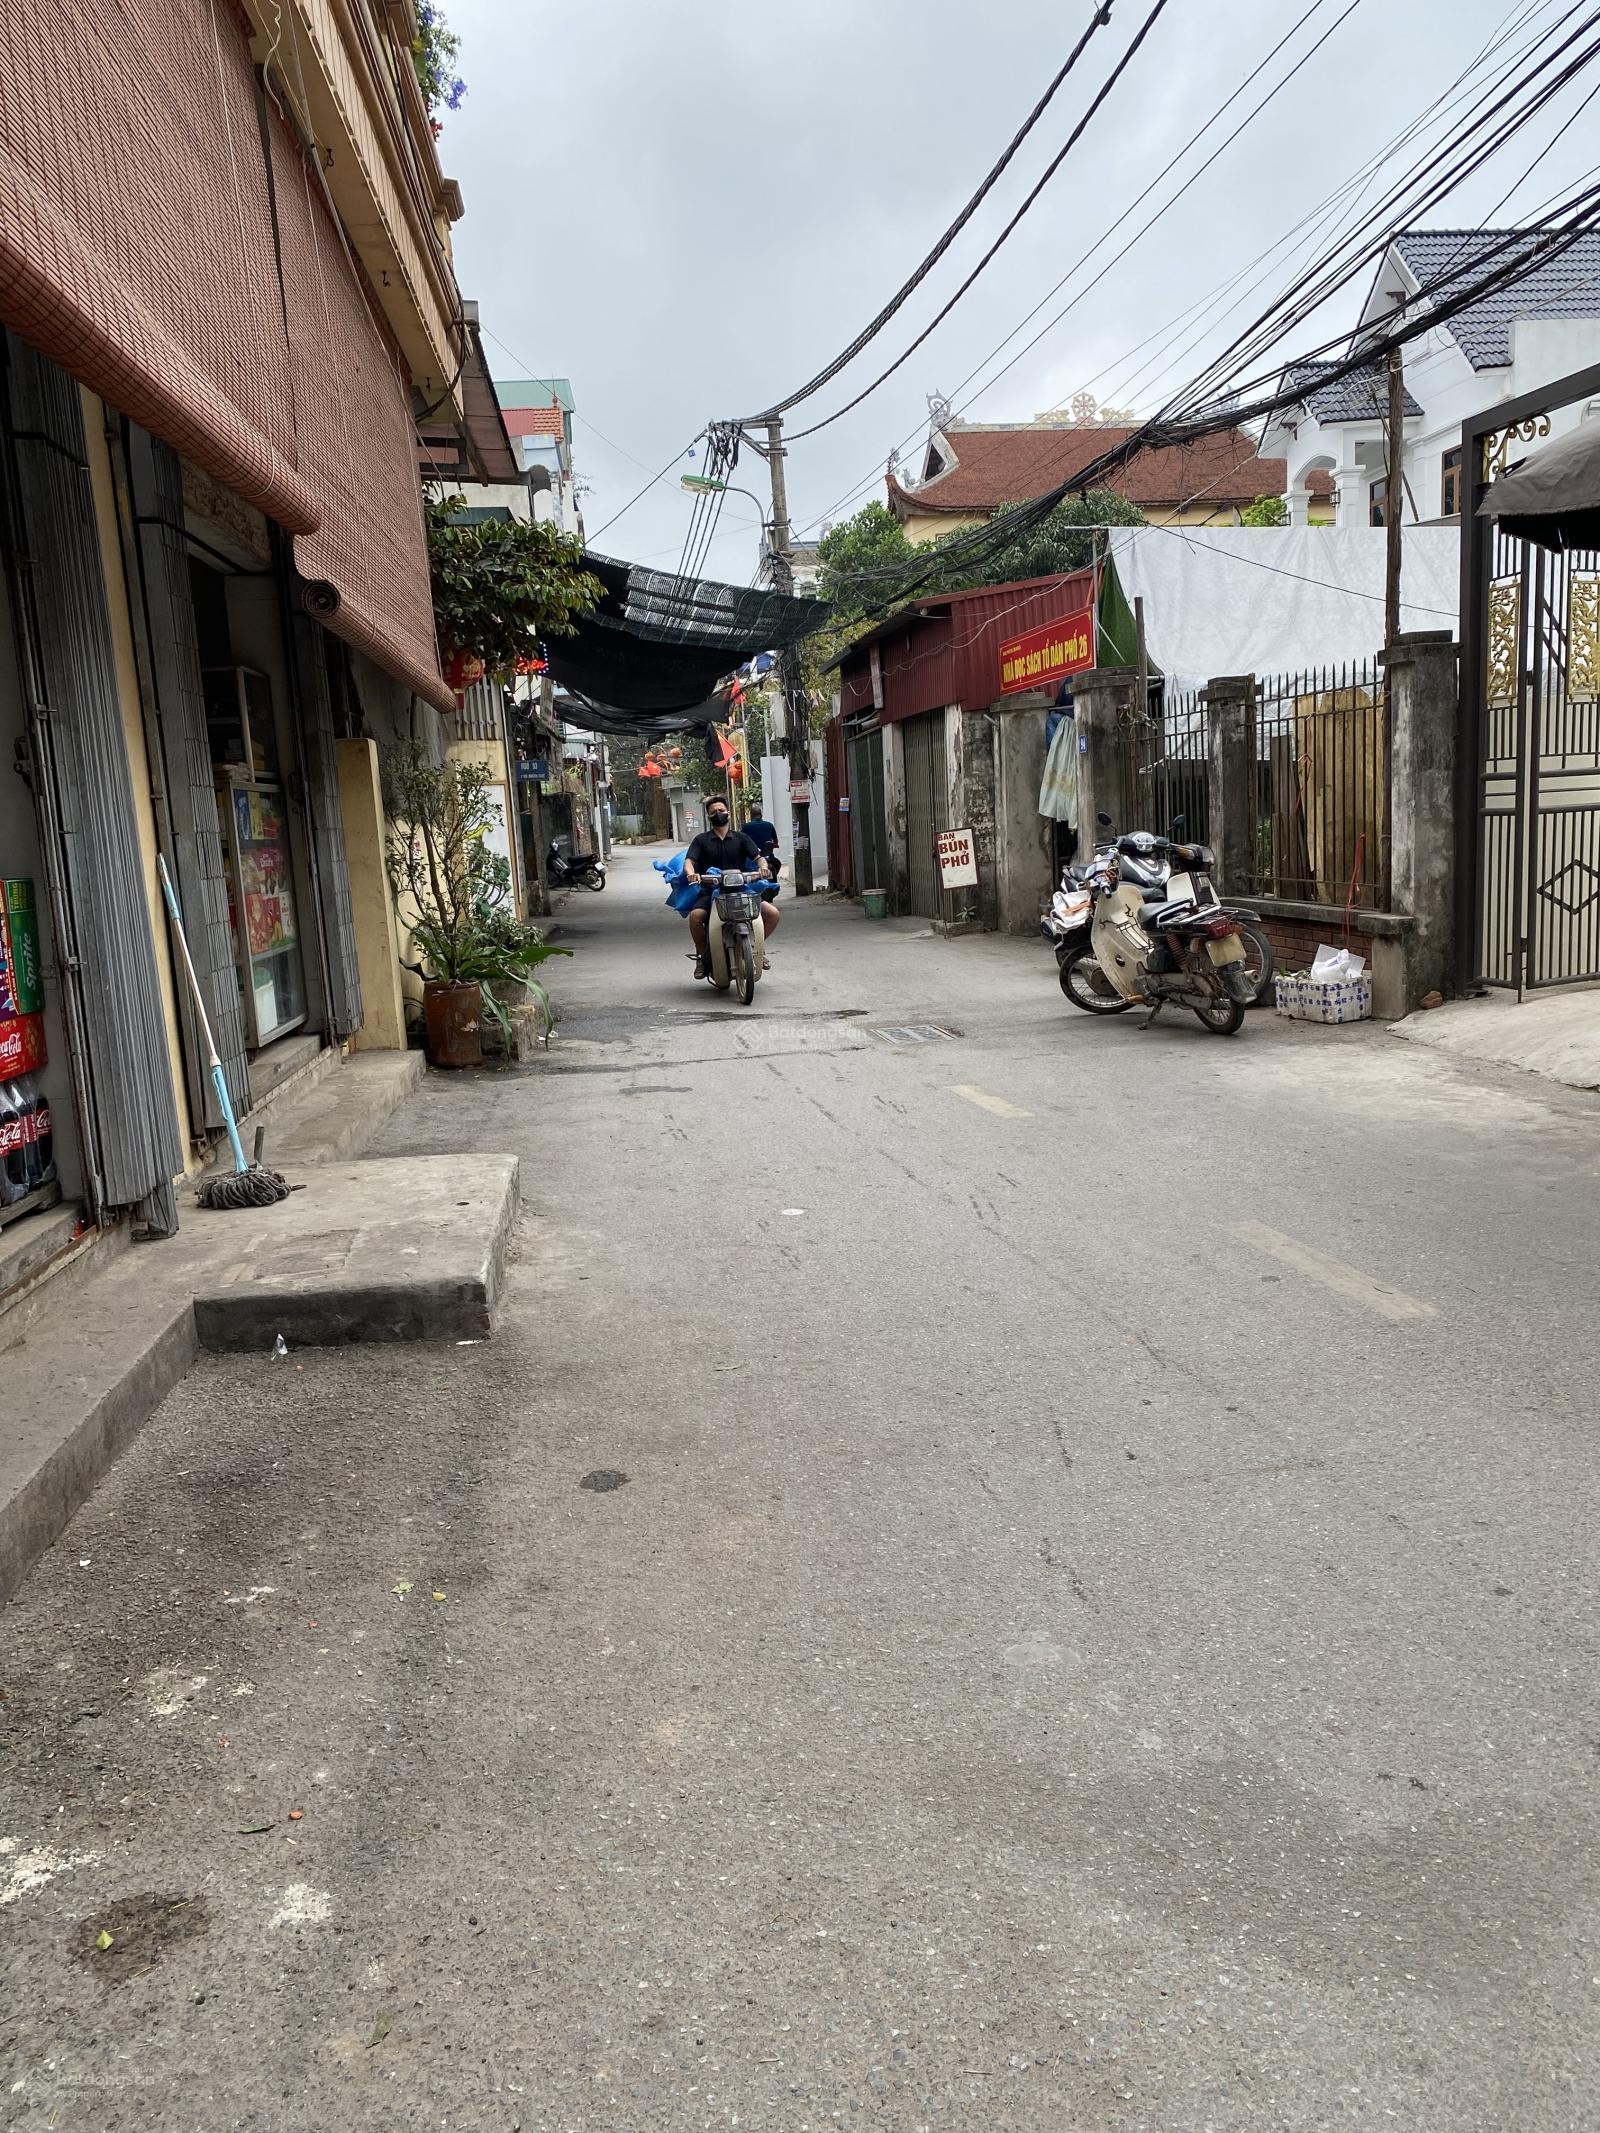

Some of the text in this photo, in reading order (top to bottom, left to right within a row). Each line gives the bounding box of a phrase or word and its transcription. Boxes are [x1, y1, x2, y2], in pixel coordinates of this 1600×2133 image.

[1026, 649, 1042, 676] SÁCH
[1064, 629, 1078, 663] PHỐ
[1078, 633, 1088, 658] 26
[939, 838, 969, 855] BÚN
[941, 850, 970, 869] PHỞ
[24, 932, 37, 991] Sprite
